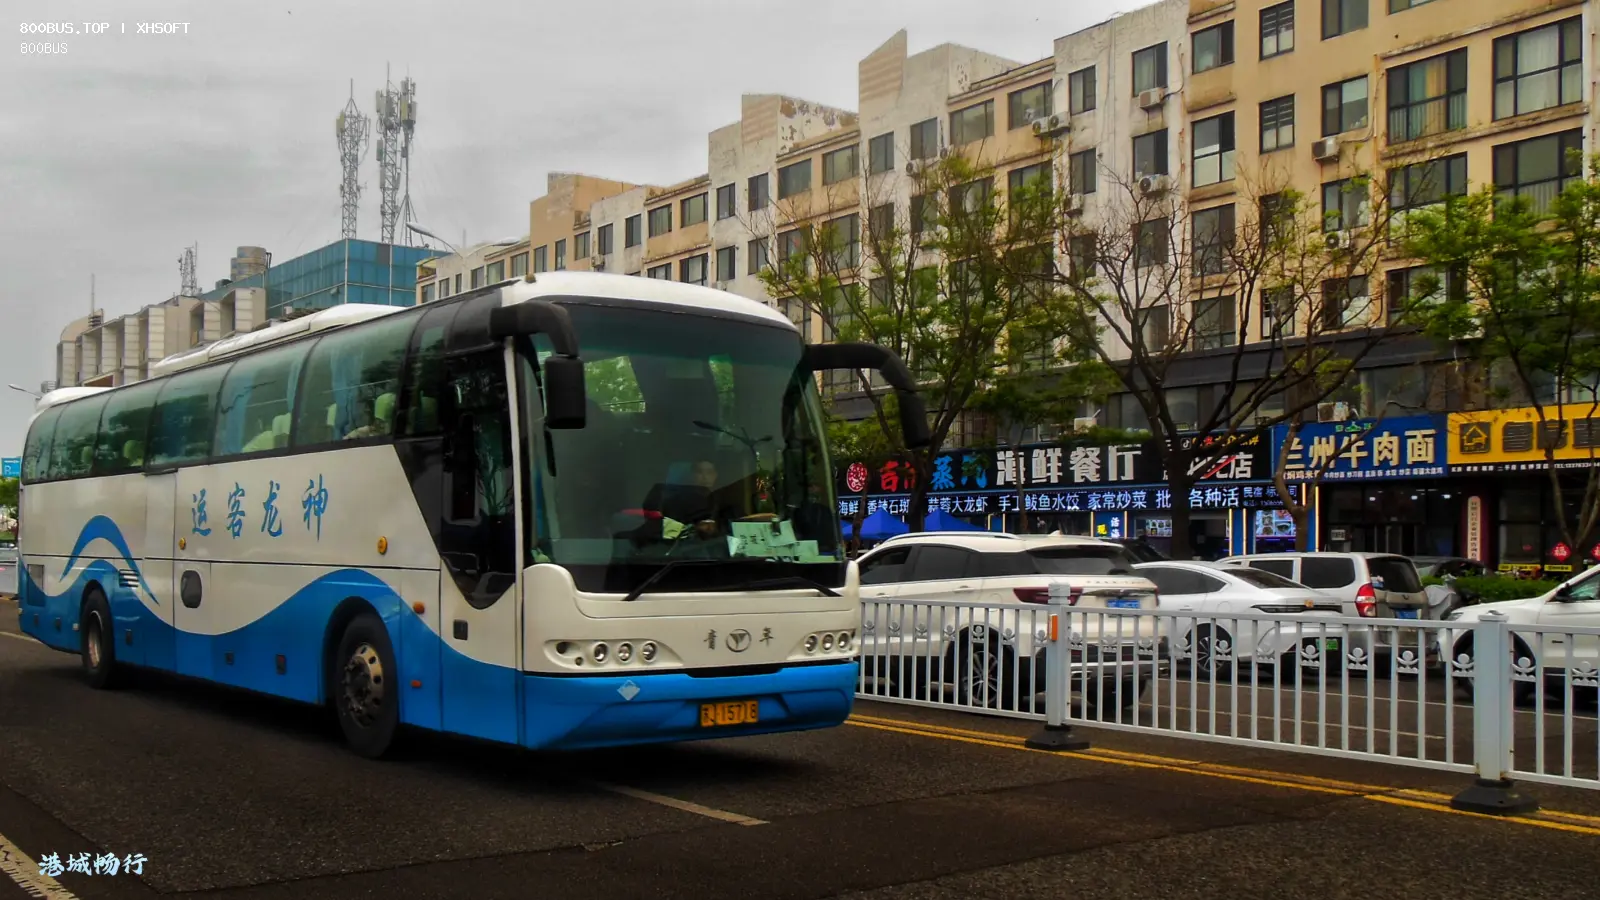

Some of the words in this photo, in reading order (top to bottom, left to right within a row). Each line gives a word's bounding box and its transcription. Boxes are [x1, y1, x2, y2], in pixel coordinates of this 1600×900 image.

[1281, 429, 1438, 470] 兰州牛肉面
[928, 496, 989, 514] 蒜蓉大龙虾
[1087, 490, 1147, 511] 家常炒菜
